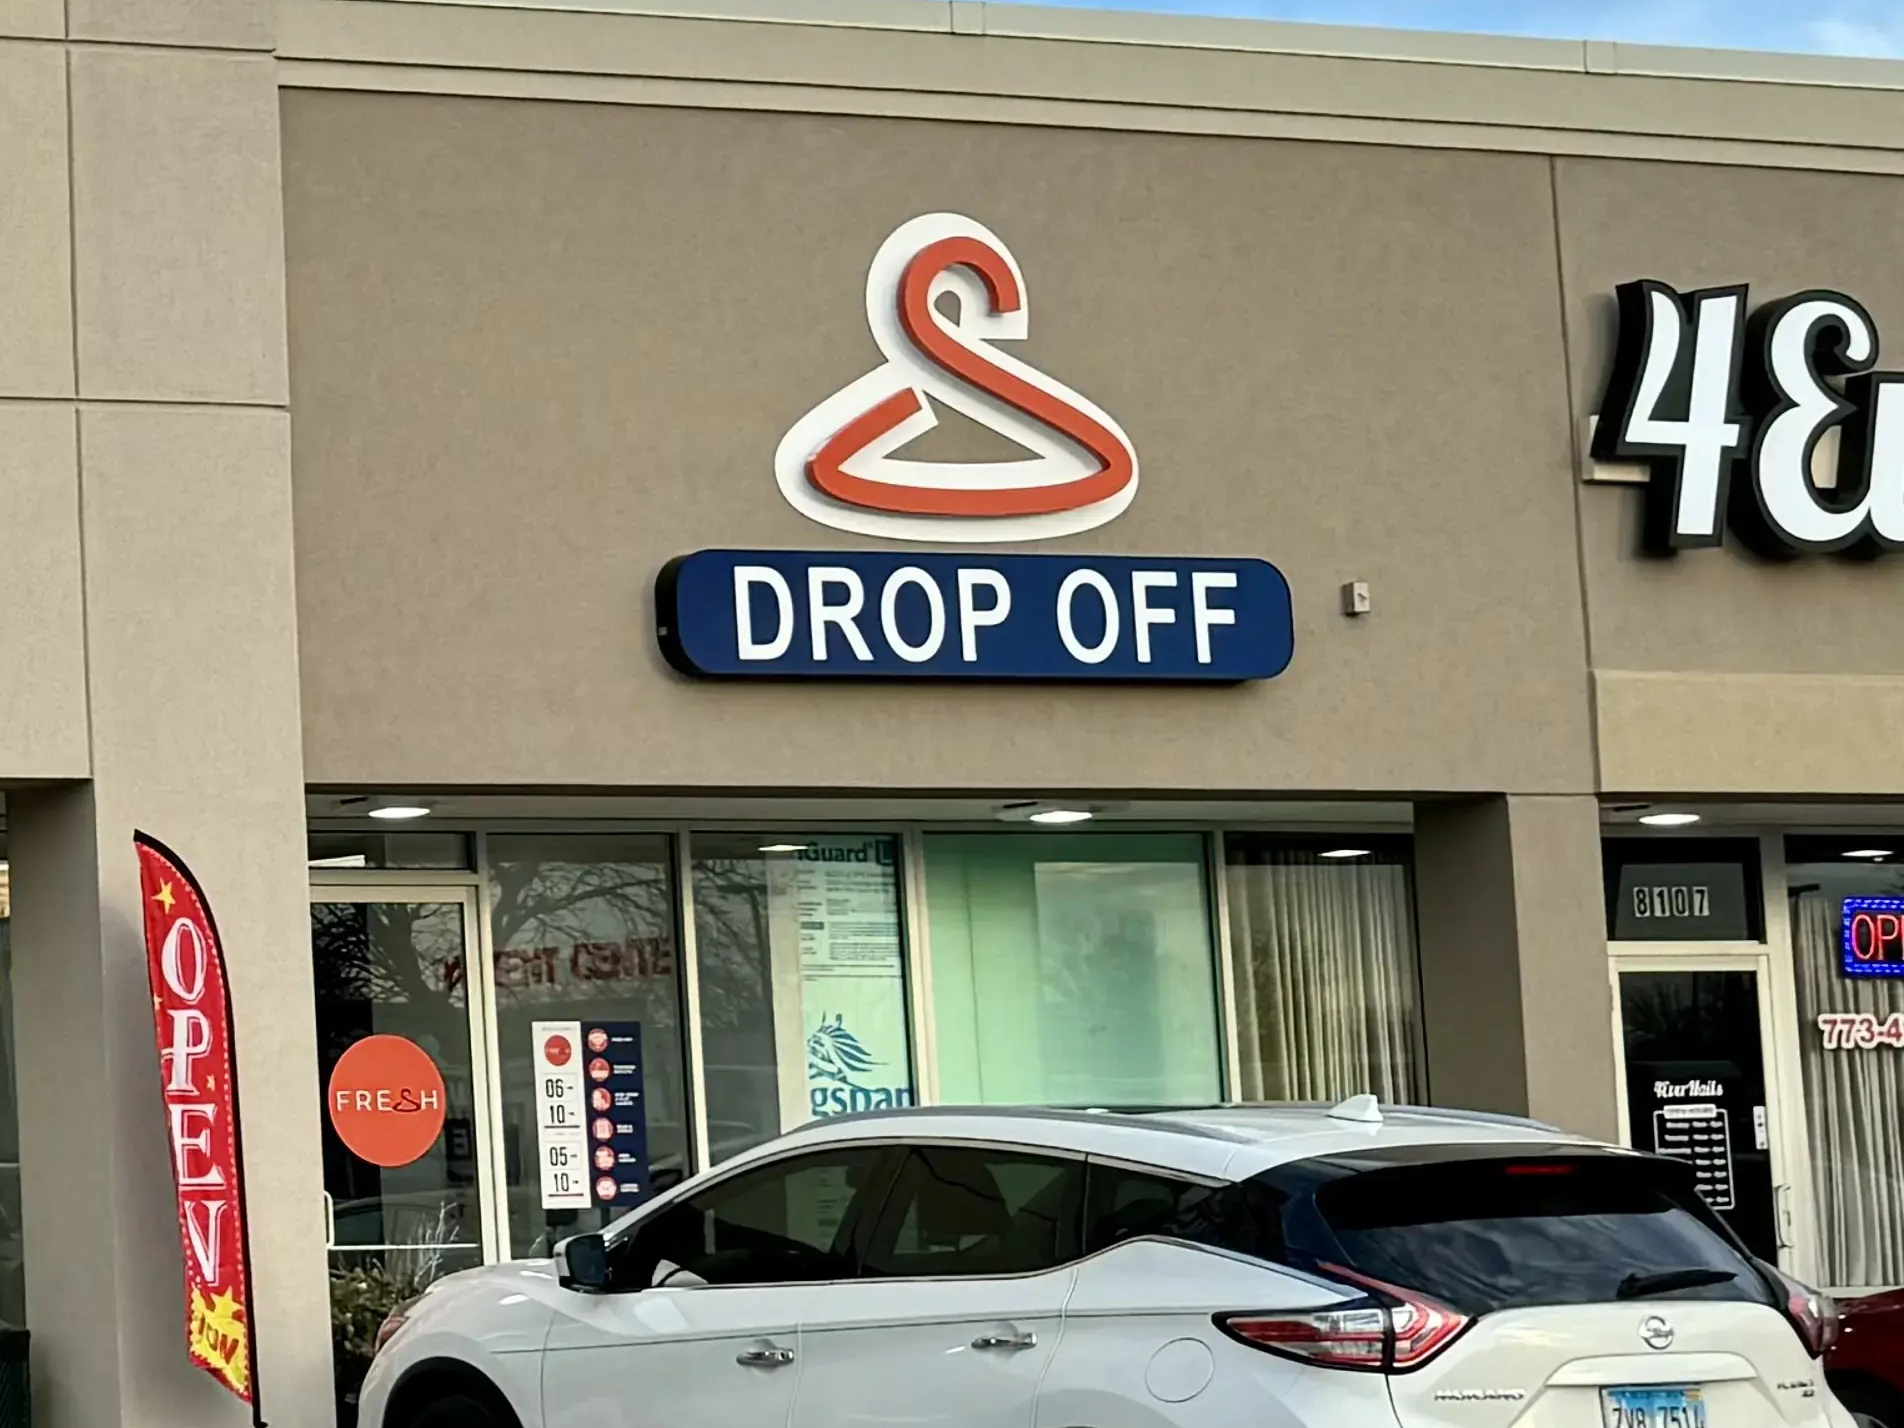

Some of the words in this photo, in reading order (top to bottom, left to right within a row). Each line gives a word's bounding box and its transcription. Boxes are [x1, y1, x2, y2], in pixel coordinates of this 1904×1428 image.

[733, 565, 1012, 663] DROP
[1056, 567, 1238, 664] OFF
[1634, 887, 1710, 917] 8107
[1849, 913, 1904, 961] OP
[545, 1079, 564, 1098] 06
[336, 1088, 438, 1113] FRESH
[549, 1105, 565, 1124] 10
[549, 1147, 568, 1166] 05
[553, 1173, 570, 1192] 10
